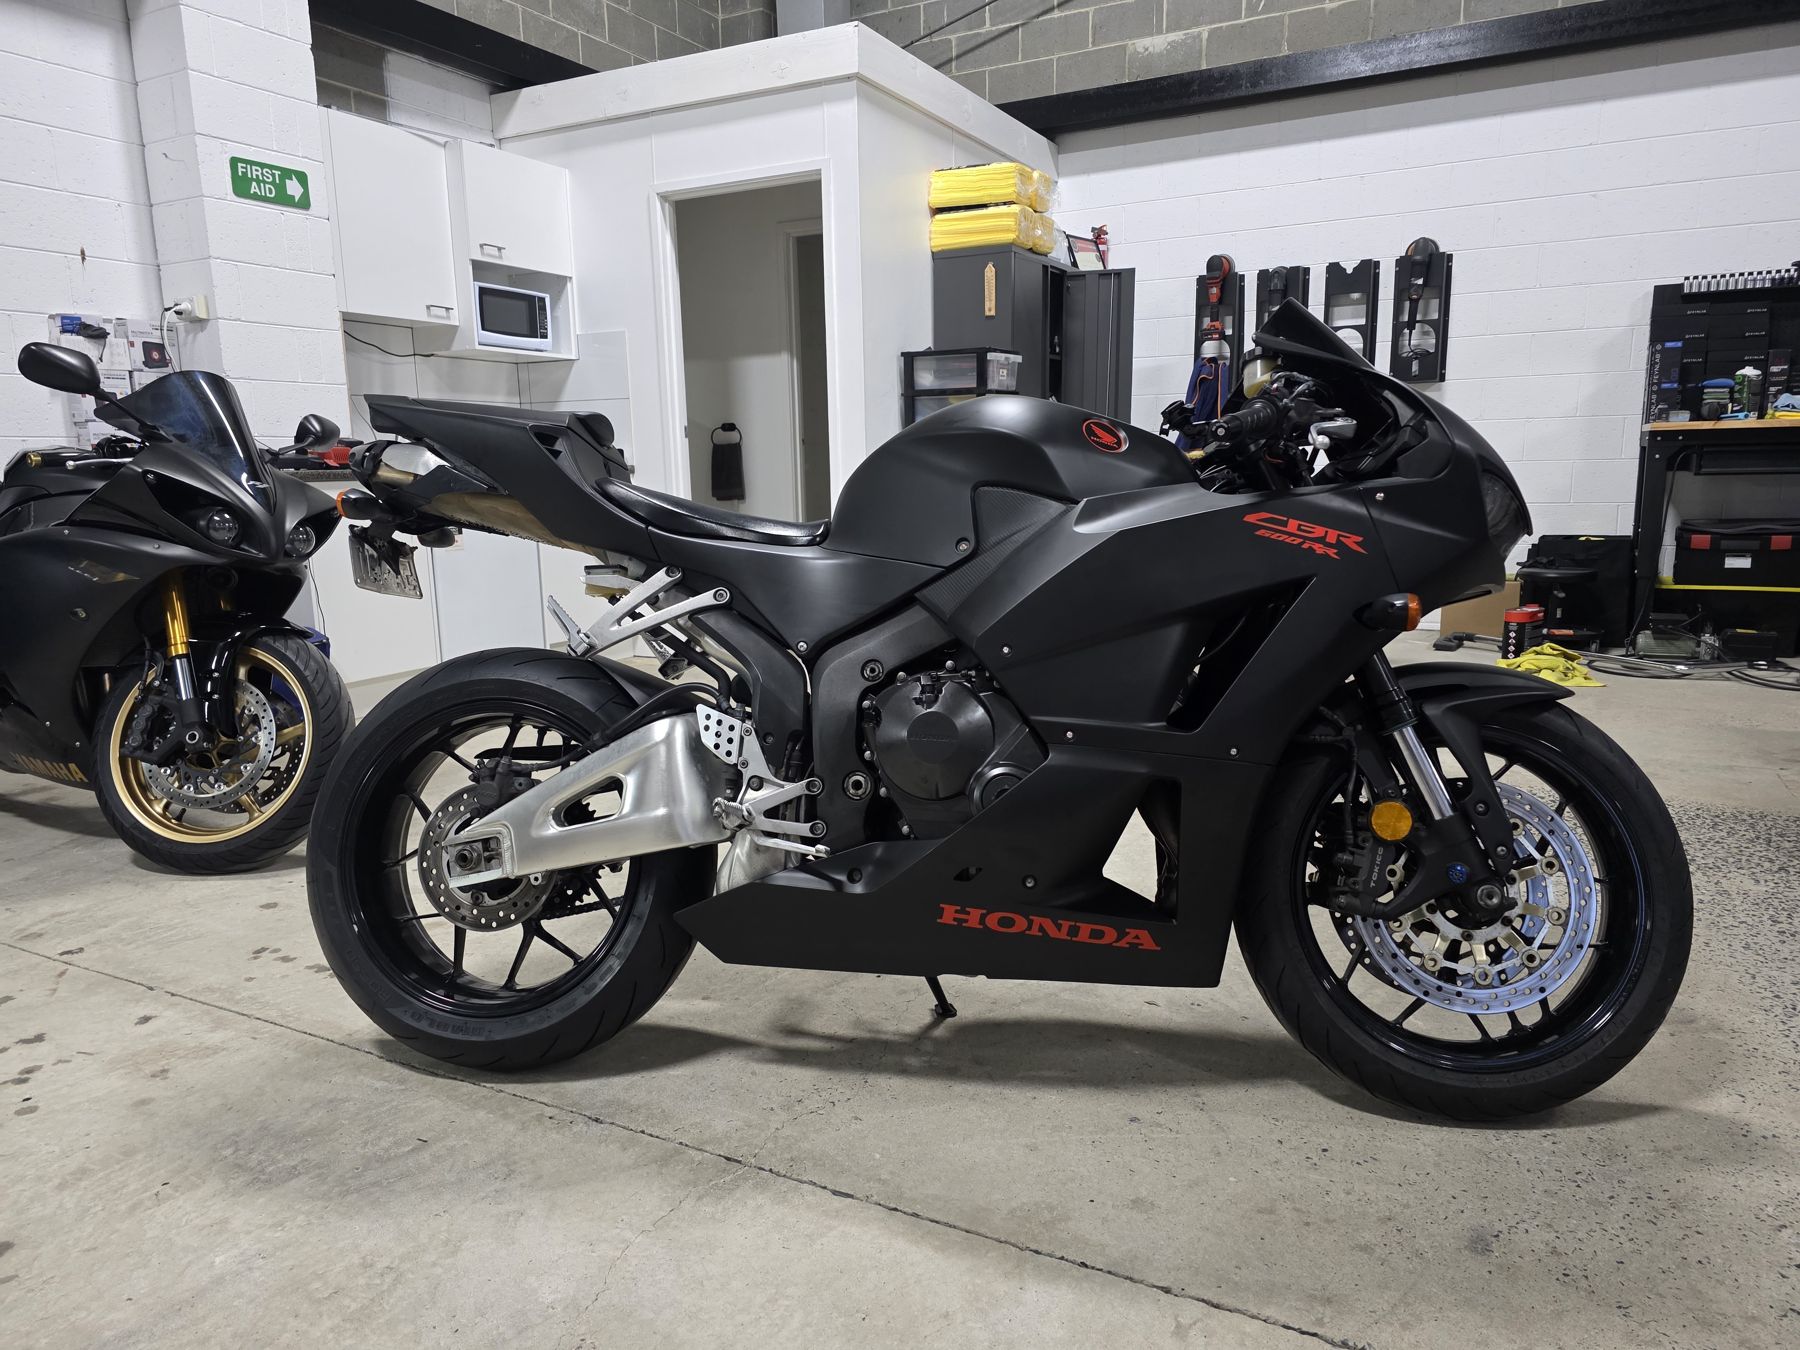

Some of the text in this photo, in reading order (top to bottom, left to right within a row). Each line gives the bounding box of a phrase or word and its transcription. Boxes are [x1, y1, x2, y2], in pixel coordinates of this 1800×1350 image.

[237, 162, 281, 184] FIRST
[250, 181, 276, 198] AID
[1242, 511, 1369, 555] CBR
[9, 752, 89, 782] YAMAHA
[1369, 847, 1384, 888] TOKICO
[937, 903, 1161, 951] HONDA
